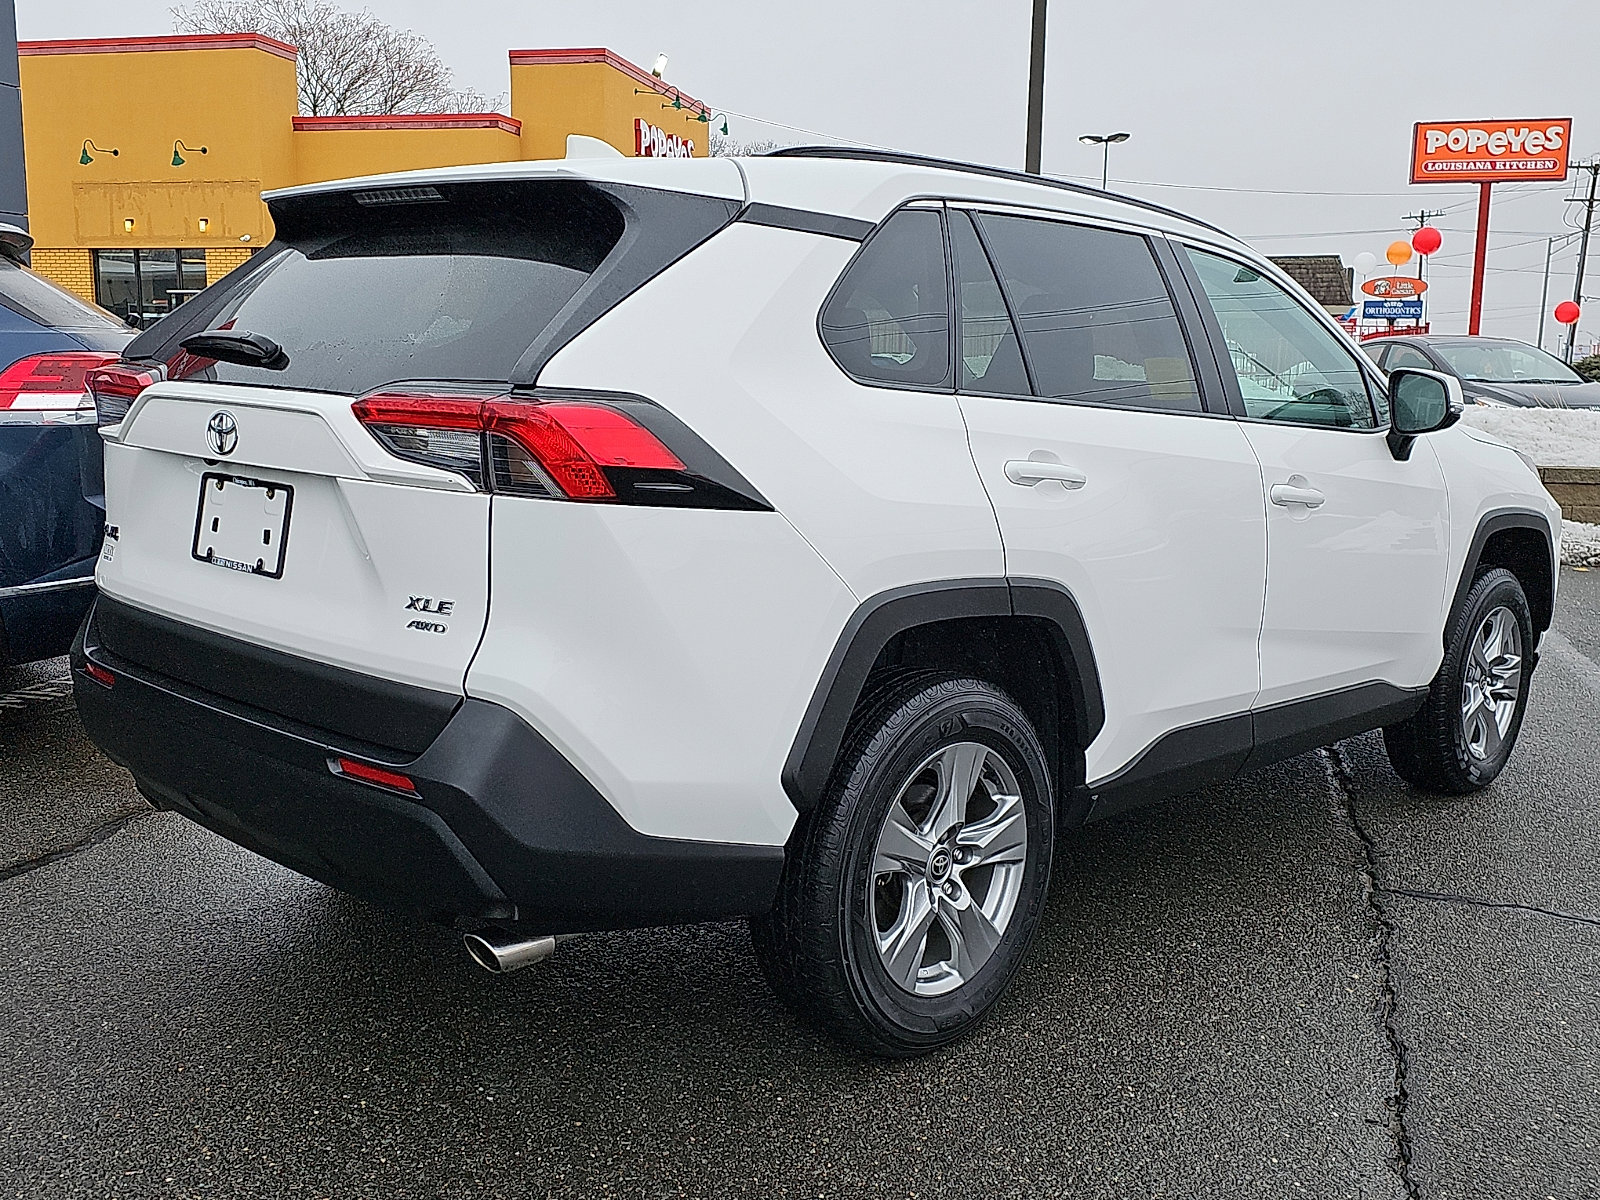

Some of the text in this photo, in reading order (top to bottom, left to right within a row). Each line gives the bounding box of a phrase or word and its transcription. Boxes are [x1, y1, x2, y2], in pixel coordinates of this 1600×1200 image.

[1427, 160, 1555, 171] LOUISIANA KITCHEN
[1364, 306, 1422, 315] ORTHODONTICS
[225, 560, 253, 573] NISSAN
[404, 595, 455, 616] XLE
[405, 619, 449, 634] AWD
